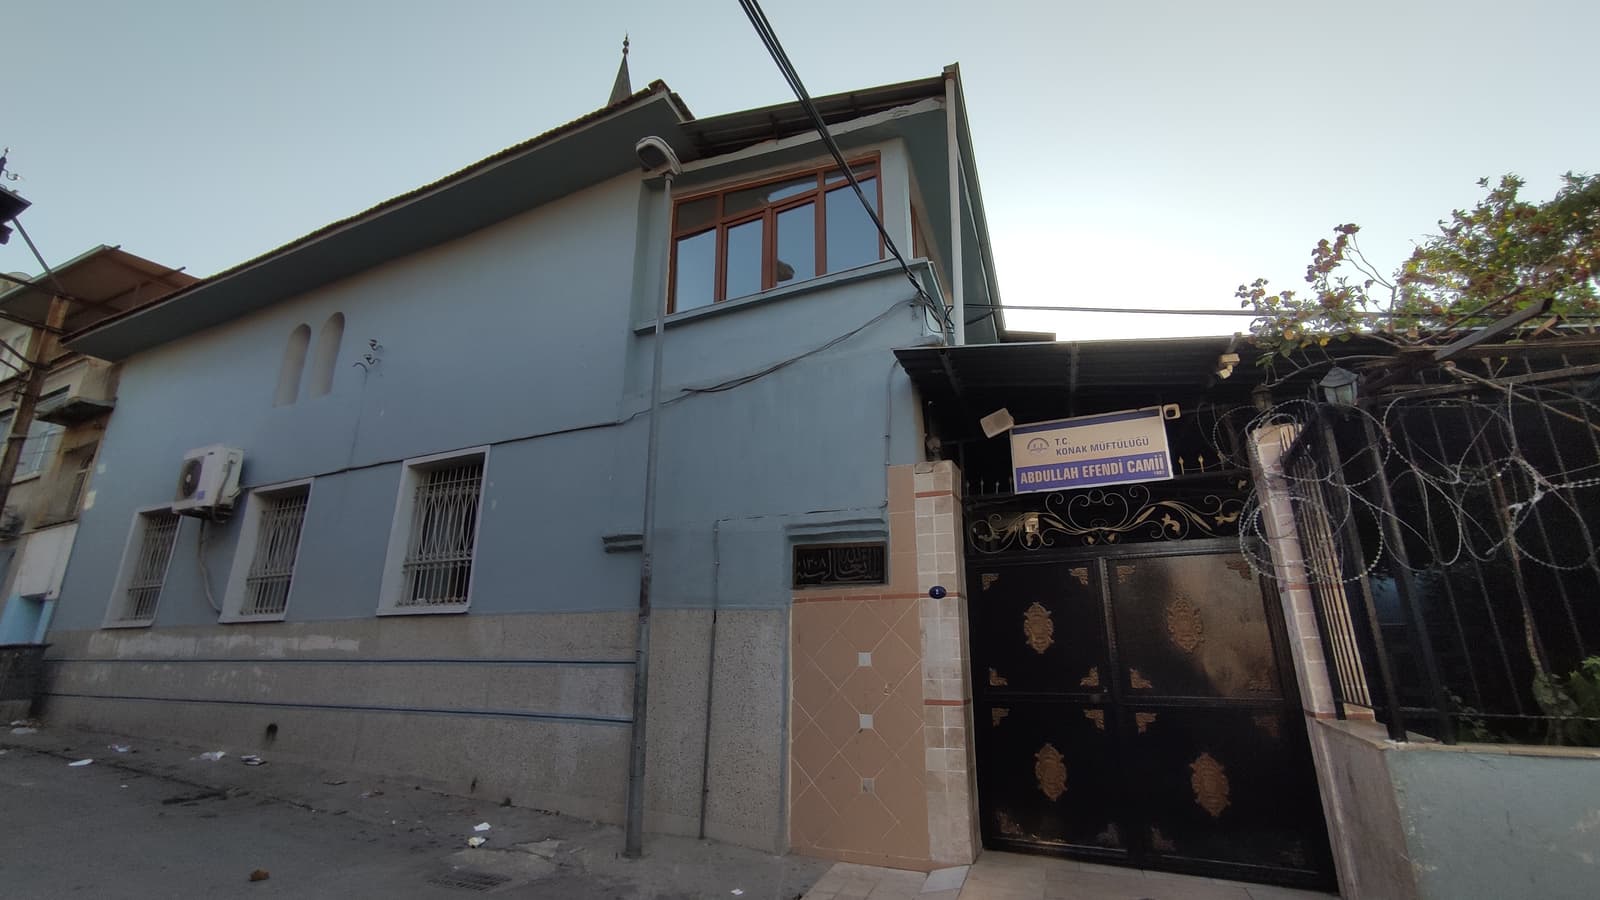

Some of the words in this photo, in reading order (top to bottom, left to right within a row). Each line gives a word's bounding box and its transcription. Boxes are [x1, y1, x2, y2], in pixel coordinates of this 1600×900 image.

[1056, 445, 1088, 457] KONAK
[1090, 436, 1149, 453] MÜFTÜLÜĞÜ
[1020, 467, 1079, 485] ABDULLAH
[1082, 459, 1124, 478] EFENDİ
[1127, 454, 1165, 472] CAMİİ
